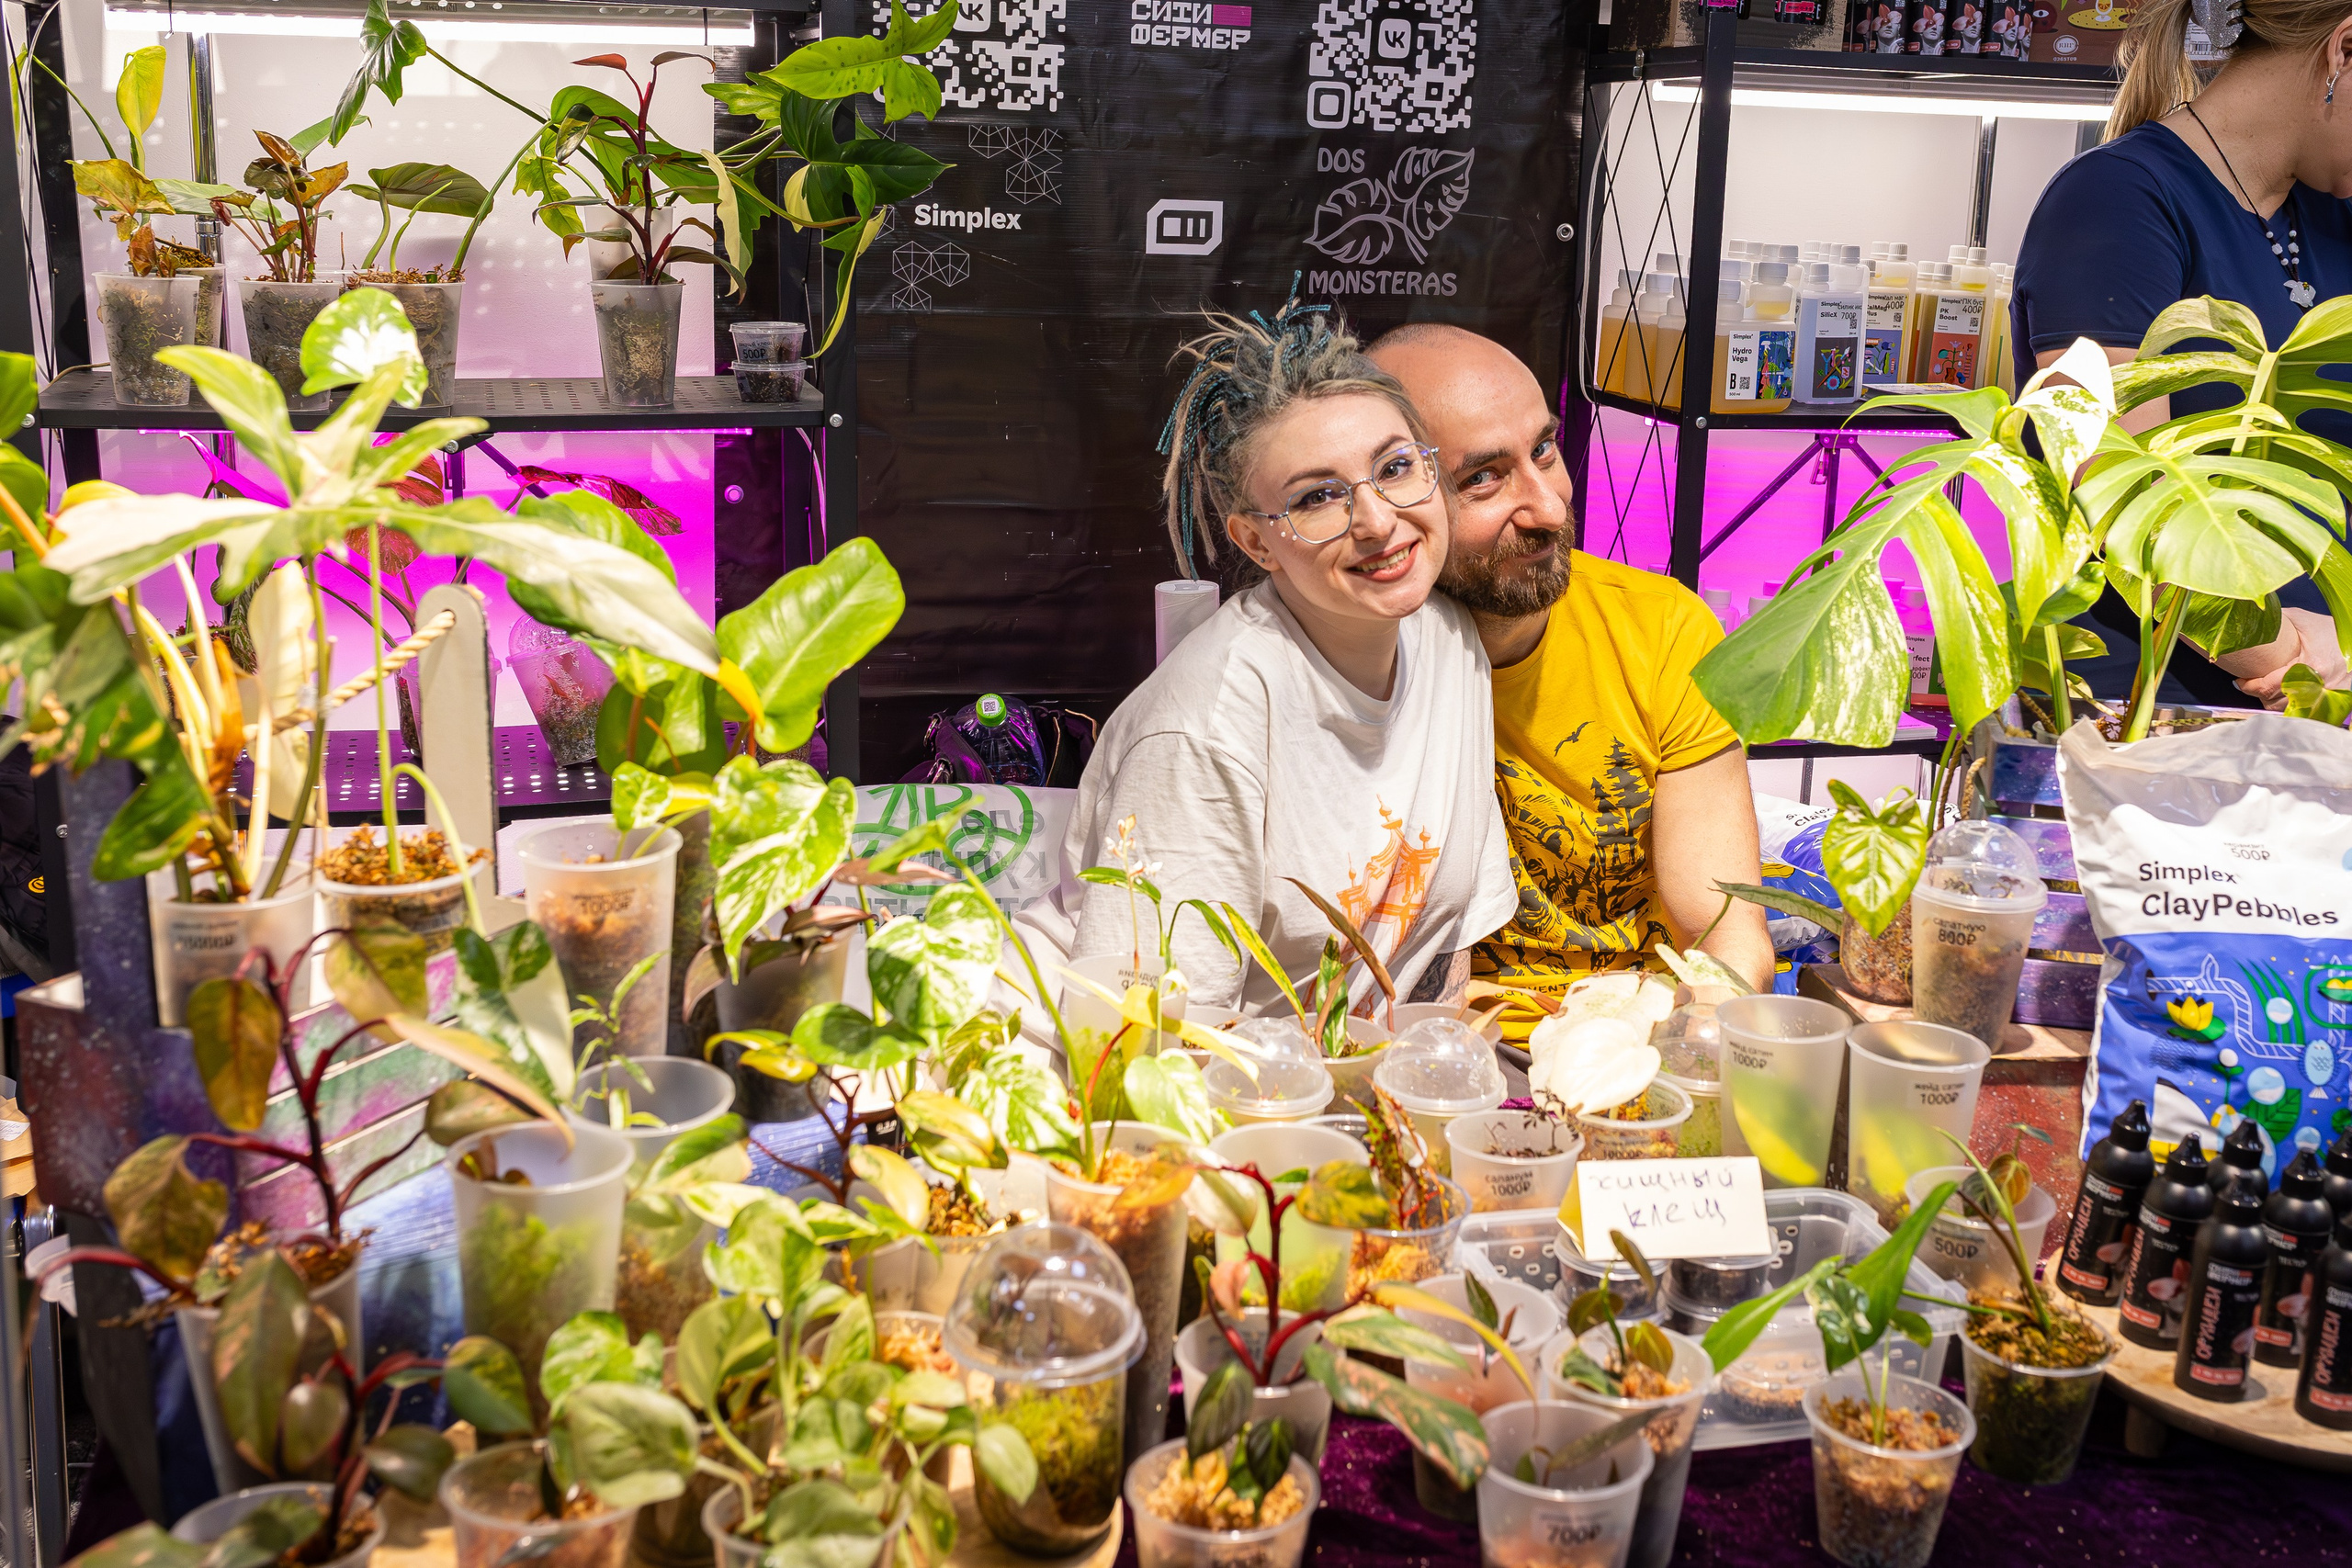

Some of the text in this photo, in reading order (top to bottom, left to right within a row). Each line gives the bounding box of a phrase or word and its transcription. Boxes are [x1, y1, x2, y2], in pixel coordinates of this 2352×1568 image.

[1131, 0, 1212, 25] СИТИ
[1130, 23, 1251, 50] ФЕРМЕР
[1385, 30, 1406, 48] VK
[1317, 147, 1365, 173] DOS
[914, 203, 1022, 233] Simplex
[1308, 270, 1457, 297] MONSTERAS
[1732, 347, 1752, 357] Hydro
[1732, 355, 1748, 364] Vega
[1730, 373, 1736, 389] B
[2139, 861, 2238, 885] Simplex
[2142, 891, 2339, 926] ClayPebbles
[1589, 1165, 1735, 1191] хищный
[1623, 1198, 1725, 1228] клещ
